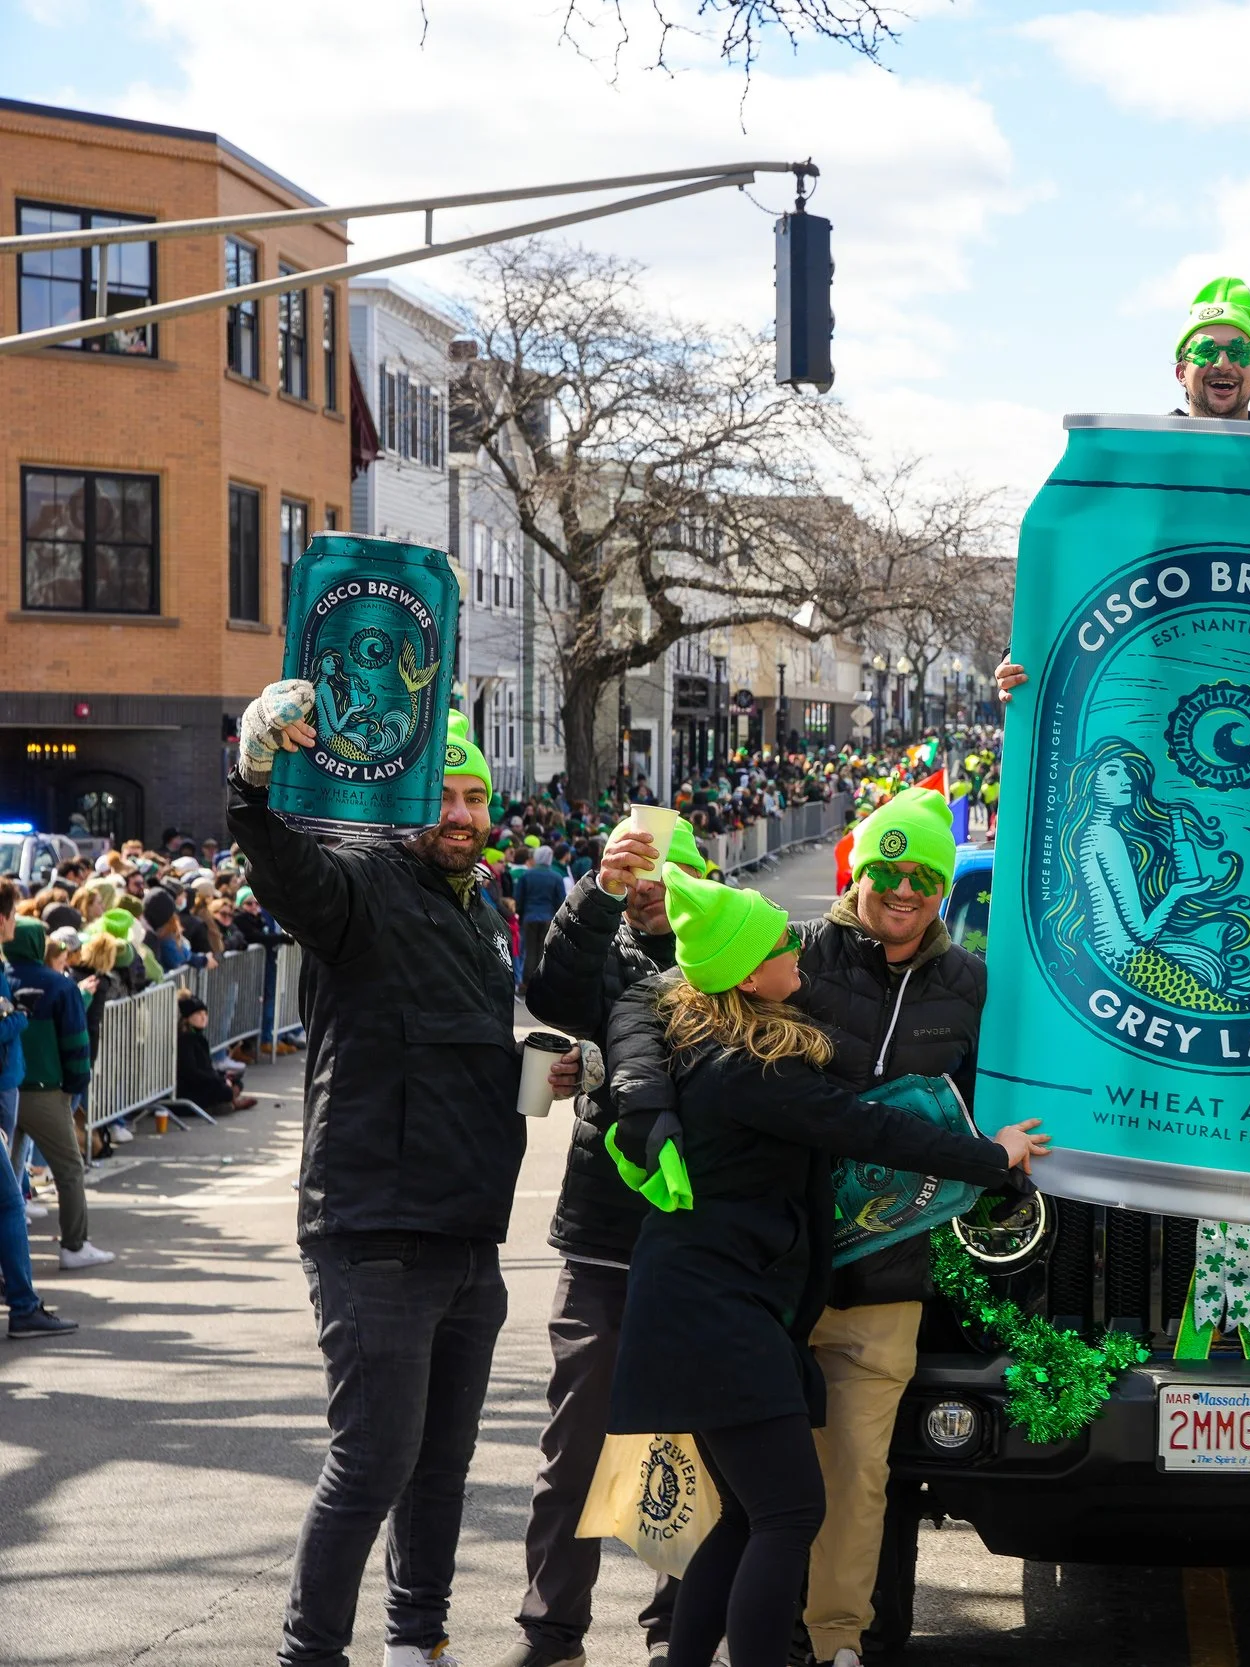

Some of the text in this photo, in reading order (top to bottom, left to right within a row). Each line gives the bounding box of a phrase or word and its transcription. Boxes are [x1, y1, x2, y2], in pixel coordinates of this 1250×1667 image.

[316, 581, 432, 629] CISCO BREWERS
[1078, 566, 1191, 652] CISCO
[1151, 622, 1186, 649] EST.
[314, 751, 405, 781] GREY LADY
[320, 787, 393, 803] WHEAT ALE
[1041, 702, 1065, 901] NICE BEER IF YOU CAN GET IT
[913, 1027, 951, 1037] SPYDER
[1088, 989, 1202, 1054] GREY
[1105, 1084, 1224, 1119] WHEAT
[1092, 1111, 1140, 1130] WITH
[1147, 1115, 1232, 1142] NATURAL
[1165, 1393, 1191, 1405] MAR
[660, 1440, 697, 1496] REWERS
[1196, 1454, 1212, 1464] The
[1213, 1454, 1236, 1466] Spirit
[1238, 1456, 1248, 1466] of
